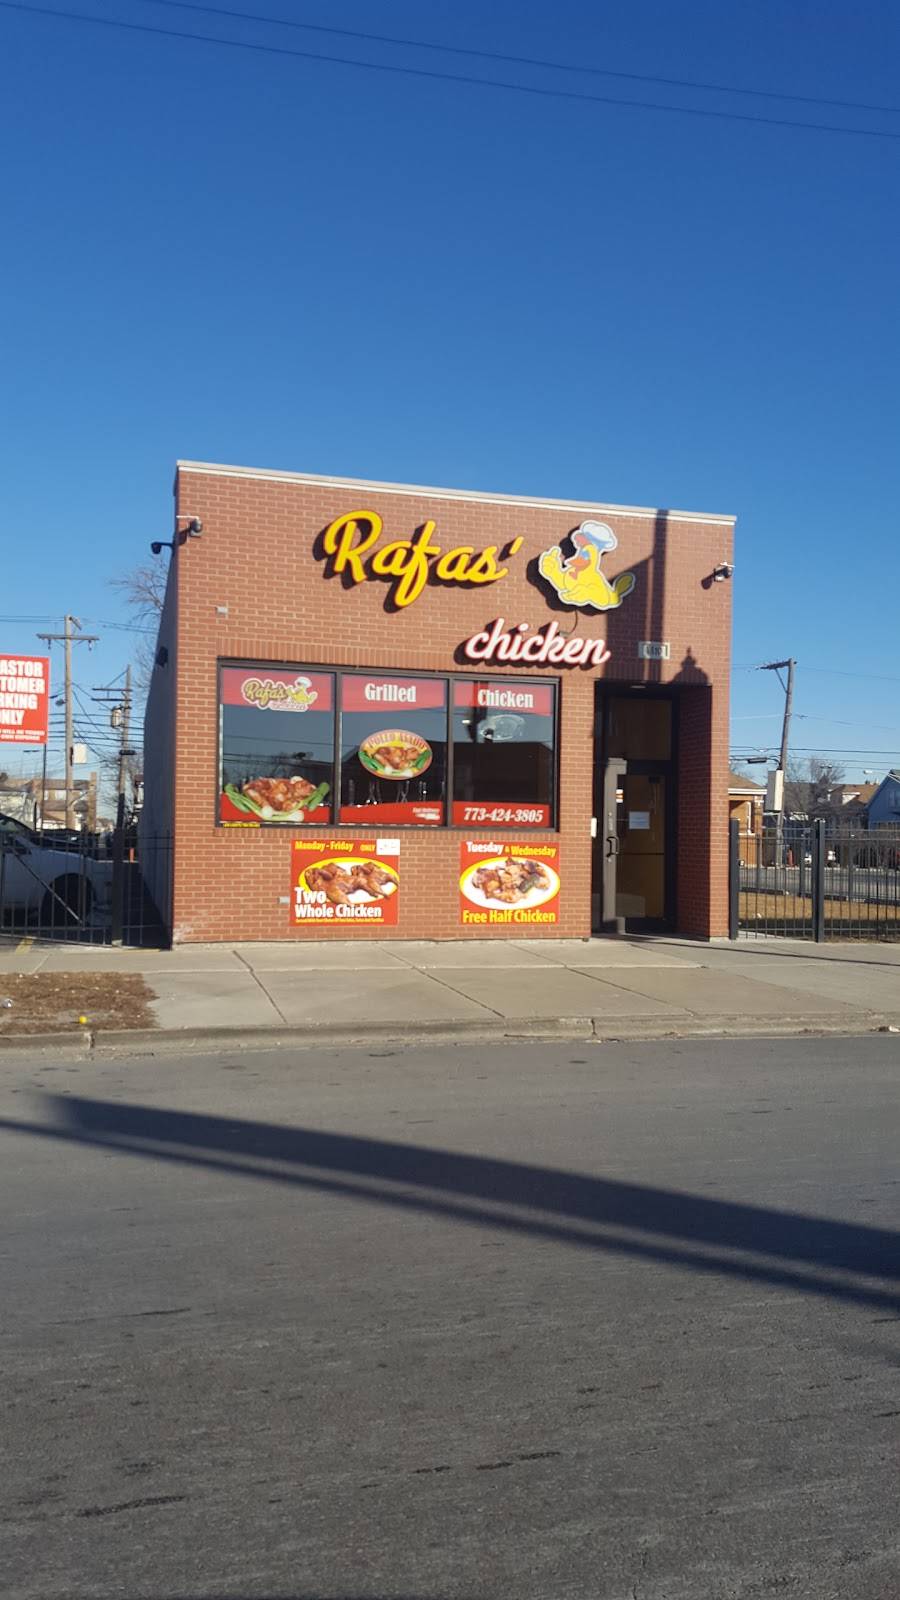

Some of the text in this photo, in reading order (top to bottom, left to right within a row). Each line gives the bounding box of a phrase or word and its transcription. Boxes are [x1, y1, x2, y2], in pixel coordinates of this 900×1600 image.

[324, 510, 524, 607] Rafas'
[465, 618, 611, 664] chicken
[365, 683, 534, 708] Grilled Chicken
[0, 709, 25, 726] NLY
[464, 807, 544, 823] 773-424-3805
[295, 841, 326, 853] Monday
[330, 841, 354, 853] Friday
[466, 841, 504, 855] Tuesday
[511, 845, 557, 858] Wednesday
[294, 887, 327, 904] Two
[295, 904, 382, 918] Whole Chicken
[463, 909, 556, 923] Free Half Chicken
